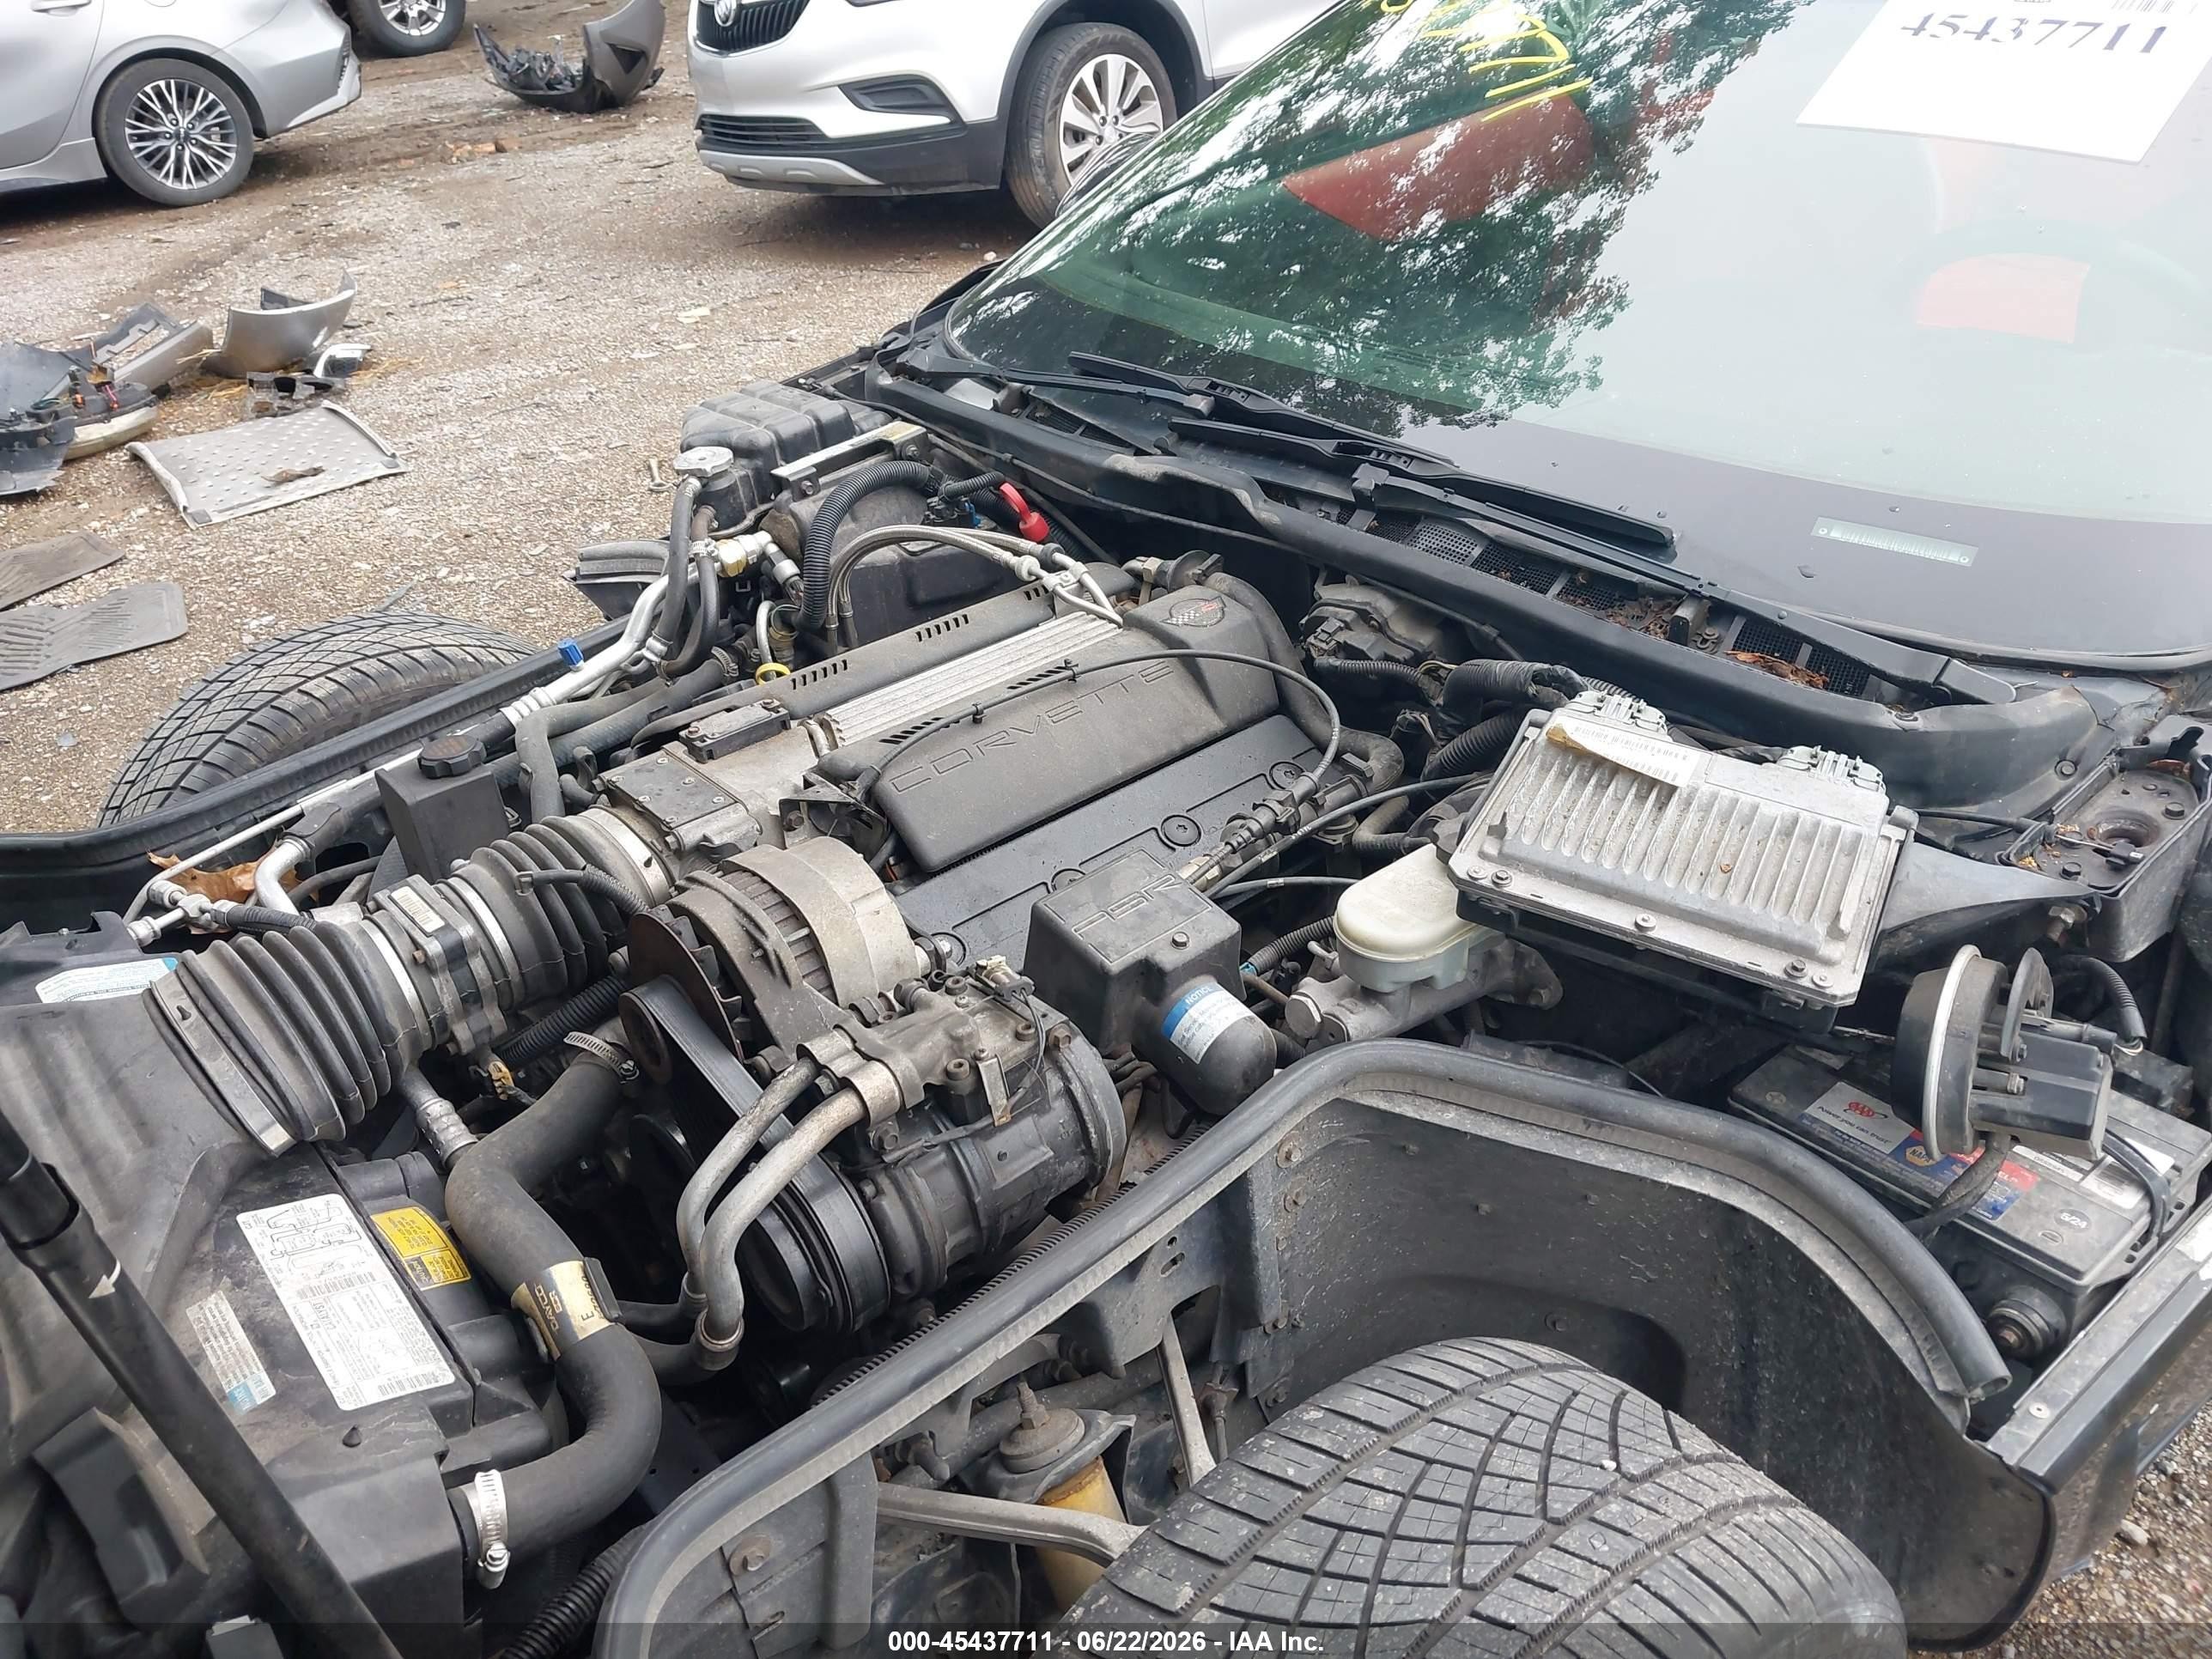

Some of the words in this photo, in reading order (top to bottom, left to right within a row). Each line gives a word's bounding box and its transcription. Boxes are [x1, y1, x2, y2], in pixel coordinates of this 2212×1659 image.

[1899, 11, 2170, 55] 45437711
[890, 659, 1175, 794] CORVETTE
[1071, 873, 1185, 941] ASR
[1184, 984, 1212, 1006] NOTICE
[1817, 1106, 1841, 1121] Power
[1855, 1126, 1869, 1134] can
[1869, 1132, 1890, 1144] trust
[312, 1301, 337, 1330] CATALYST
[534, 1285, 558, 1331] DAYCO
